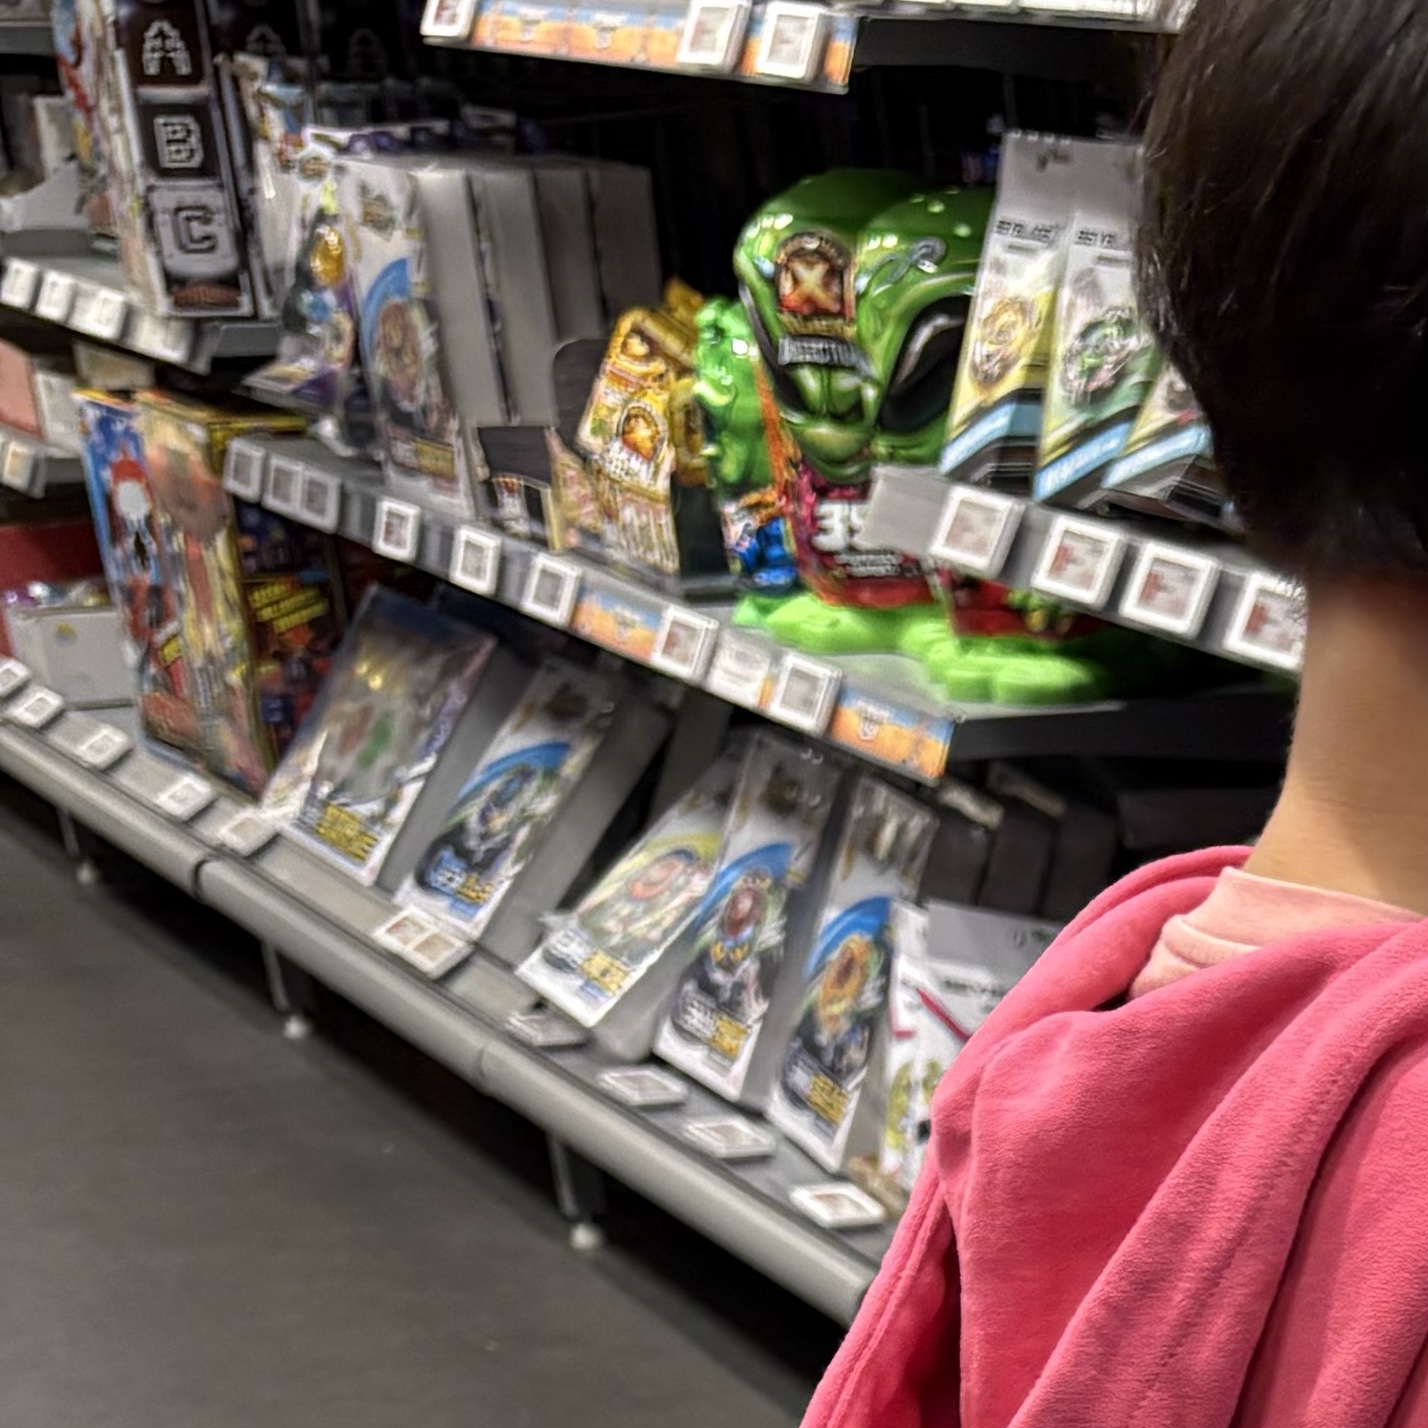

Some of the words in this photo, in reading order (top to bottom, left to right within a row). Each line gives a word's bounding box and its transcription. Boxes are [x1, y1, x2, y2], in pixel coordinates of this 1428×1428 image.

[142, 19, 192, 76] A
[153, 114, 203, 168] B
[173, 205, 217, 253] C
